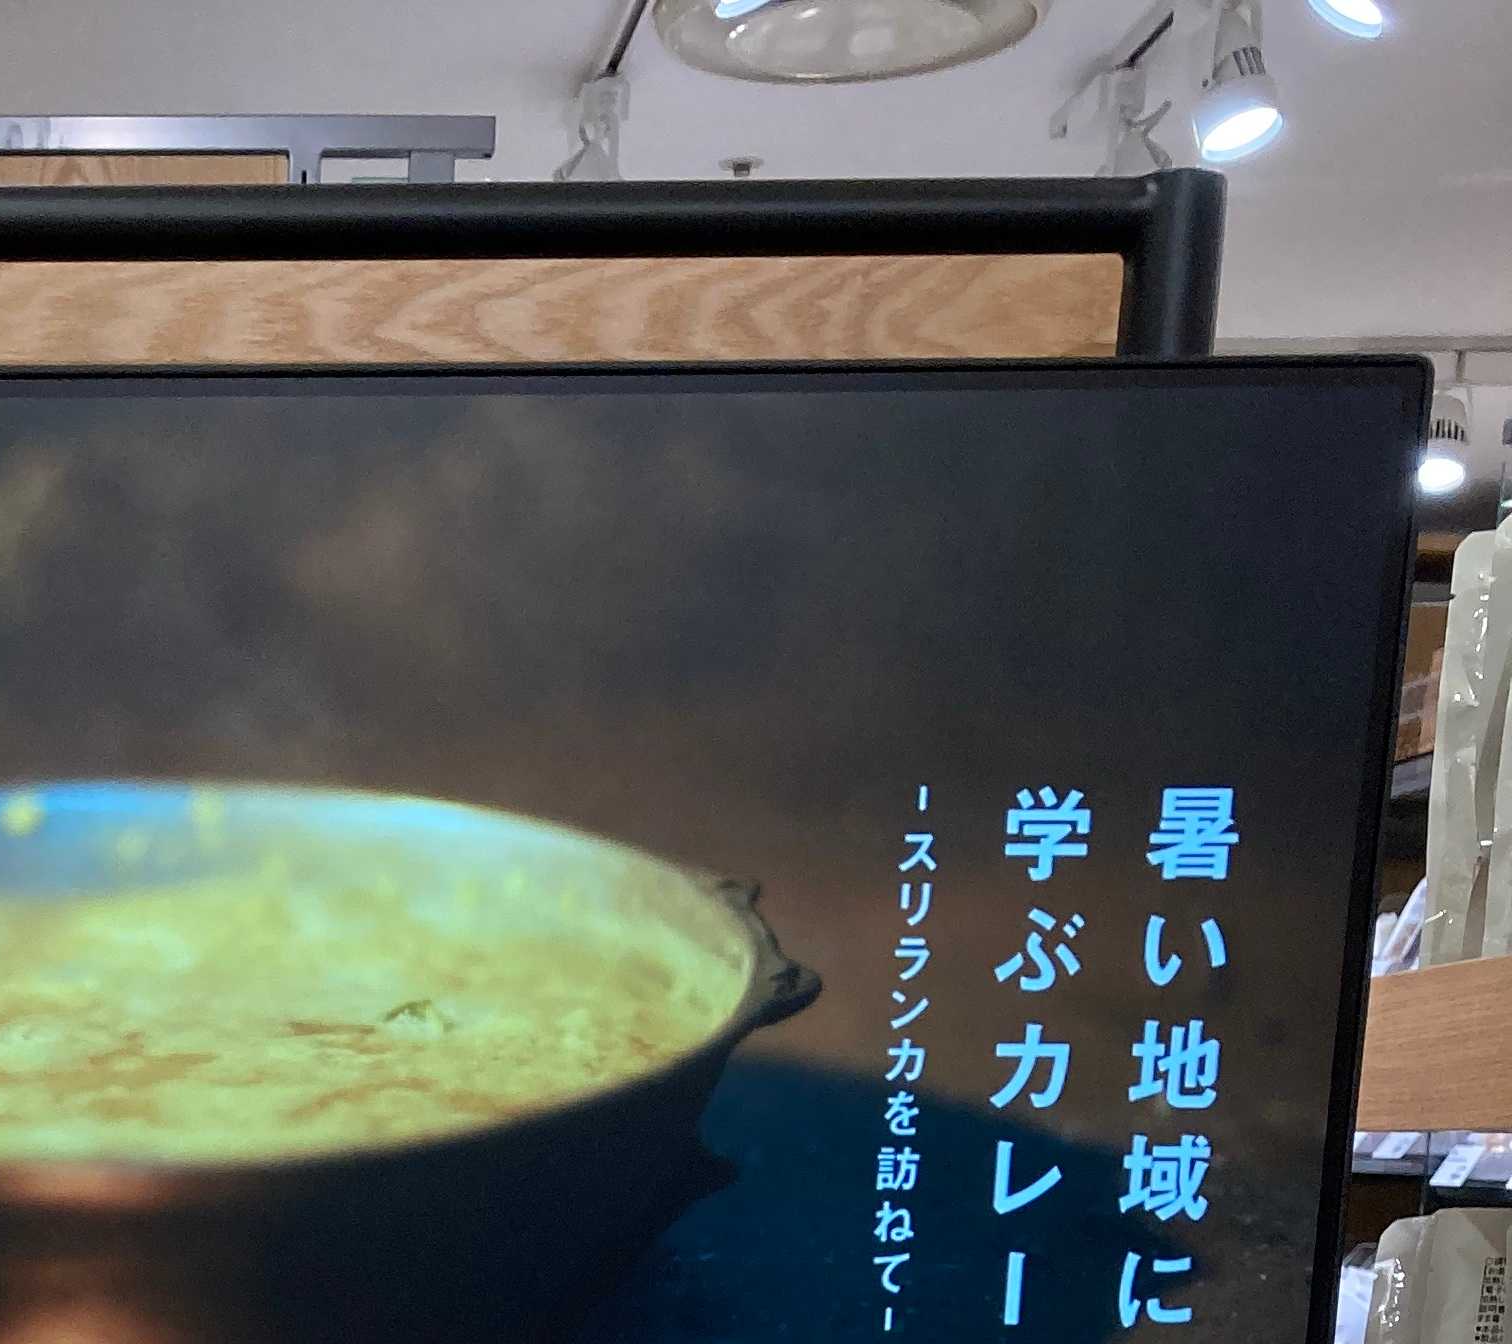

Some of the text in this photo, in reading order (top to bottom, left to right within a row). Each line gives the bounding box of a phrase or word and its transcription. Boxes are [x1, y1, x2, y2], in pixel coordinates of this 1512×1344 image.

[989, 785, 1092, 1326] 学ぶカレー
[1118, 786, 1240, 1329] 暑い地域に
